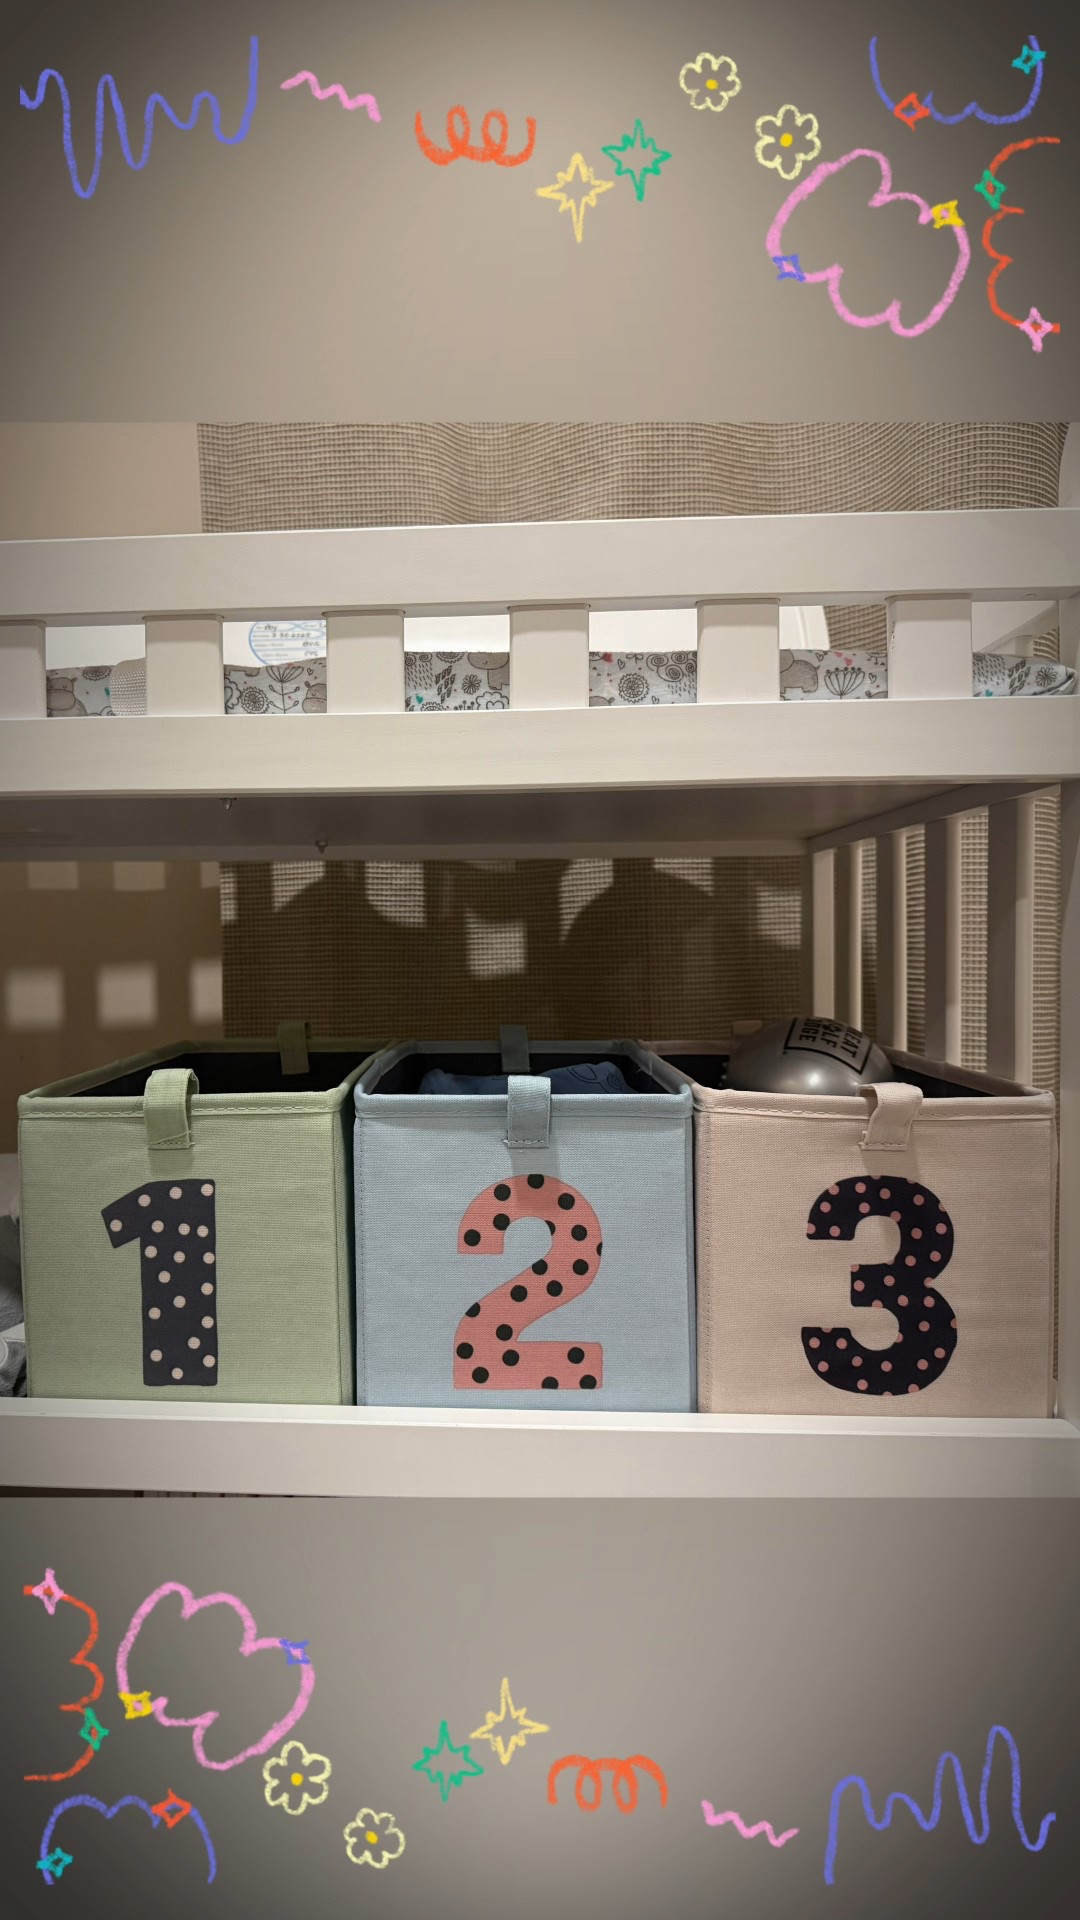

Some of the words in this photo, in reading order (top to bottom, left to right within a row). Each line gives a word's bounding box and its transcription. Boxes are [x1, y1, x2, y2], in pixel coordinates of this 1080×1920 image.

[101, 1179, 218, 1387] 1
[454, 1174, 603, 1390] 2
[801, 1175, 958, 1396] 3
